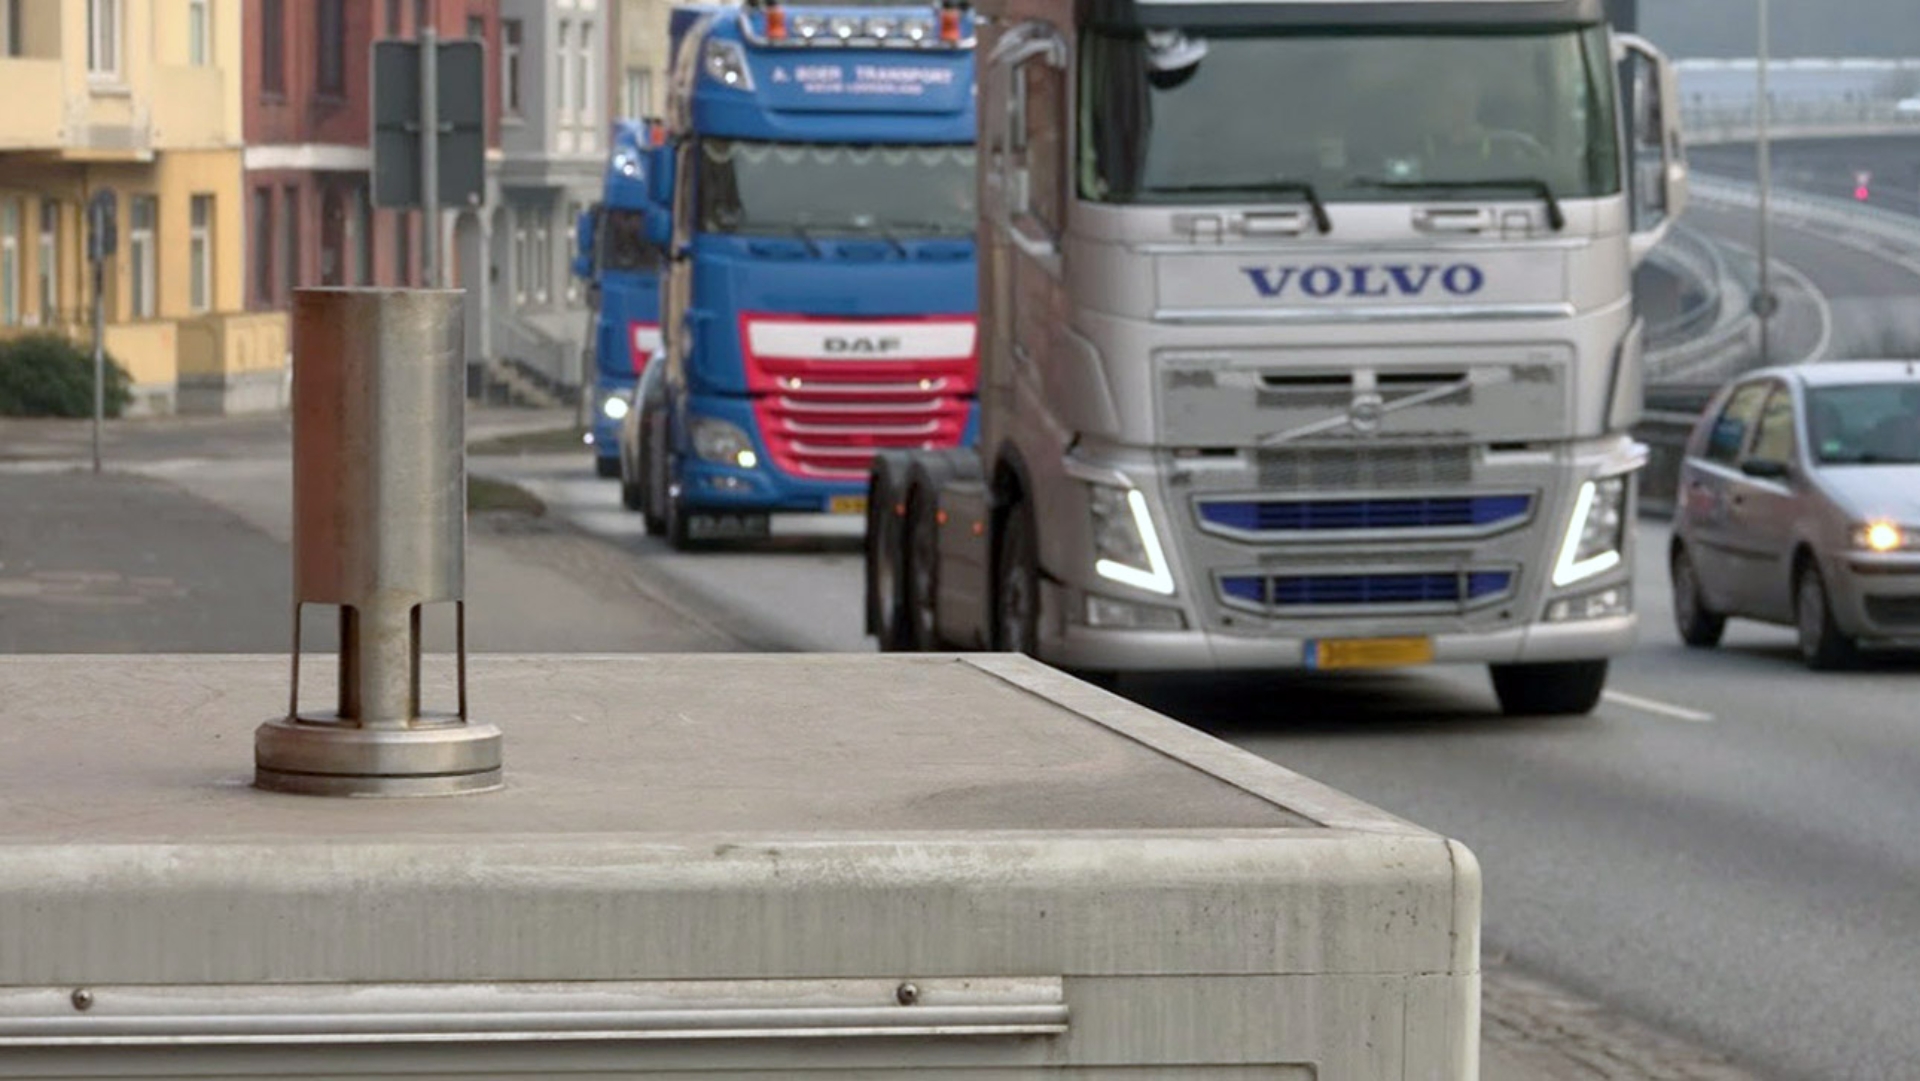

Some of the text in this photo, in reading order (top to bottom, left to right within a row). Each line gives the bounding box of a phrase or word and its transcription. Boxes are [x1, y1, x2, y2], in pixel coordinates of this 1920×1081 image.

[855, 65, 953, 85] TRANSPORT
[1239, 264, 1484, 298] VOLVO
[823, 336, 901, 353] DAF
